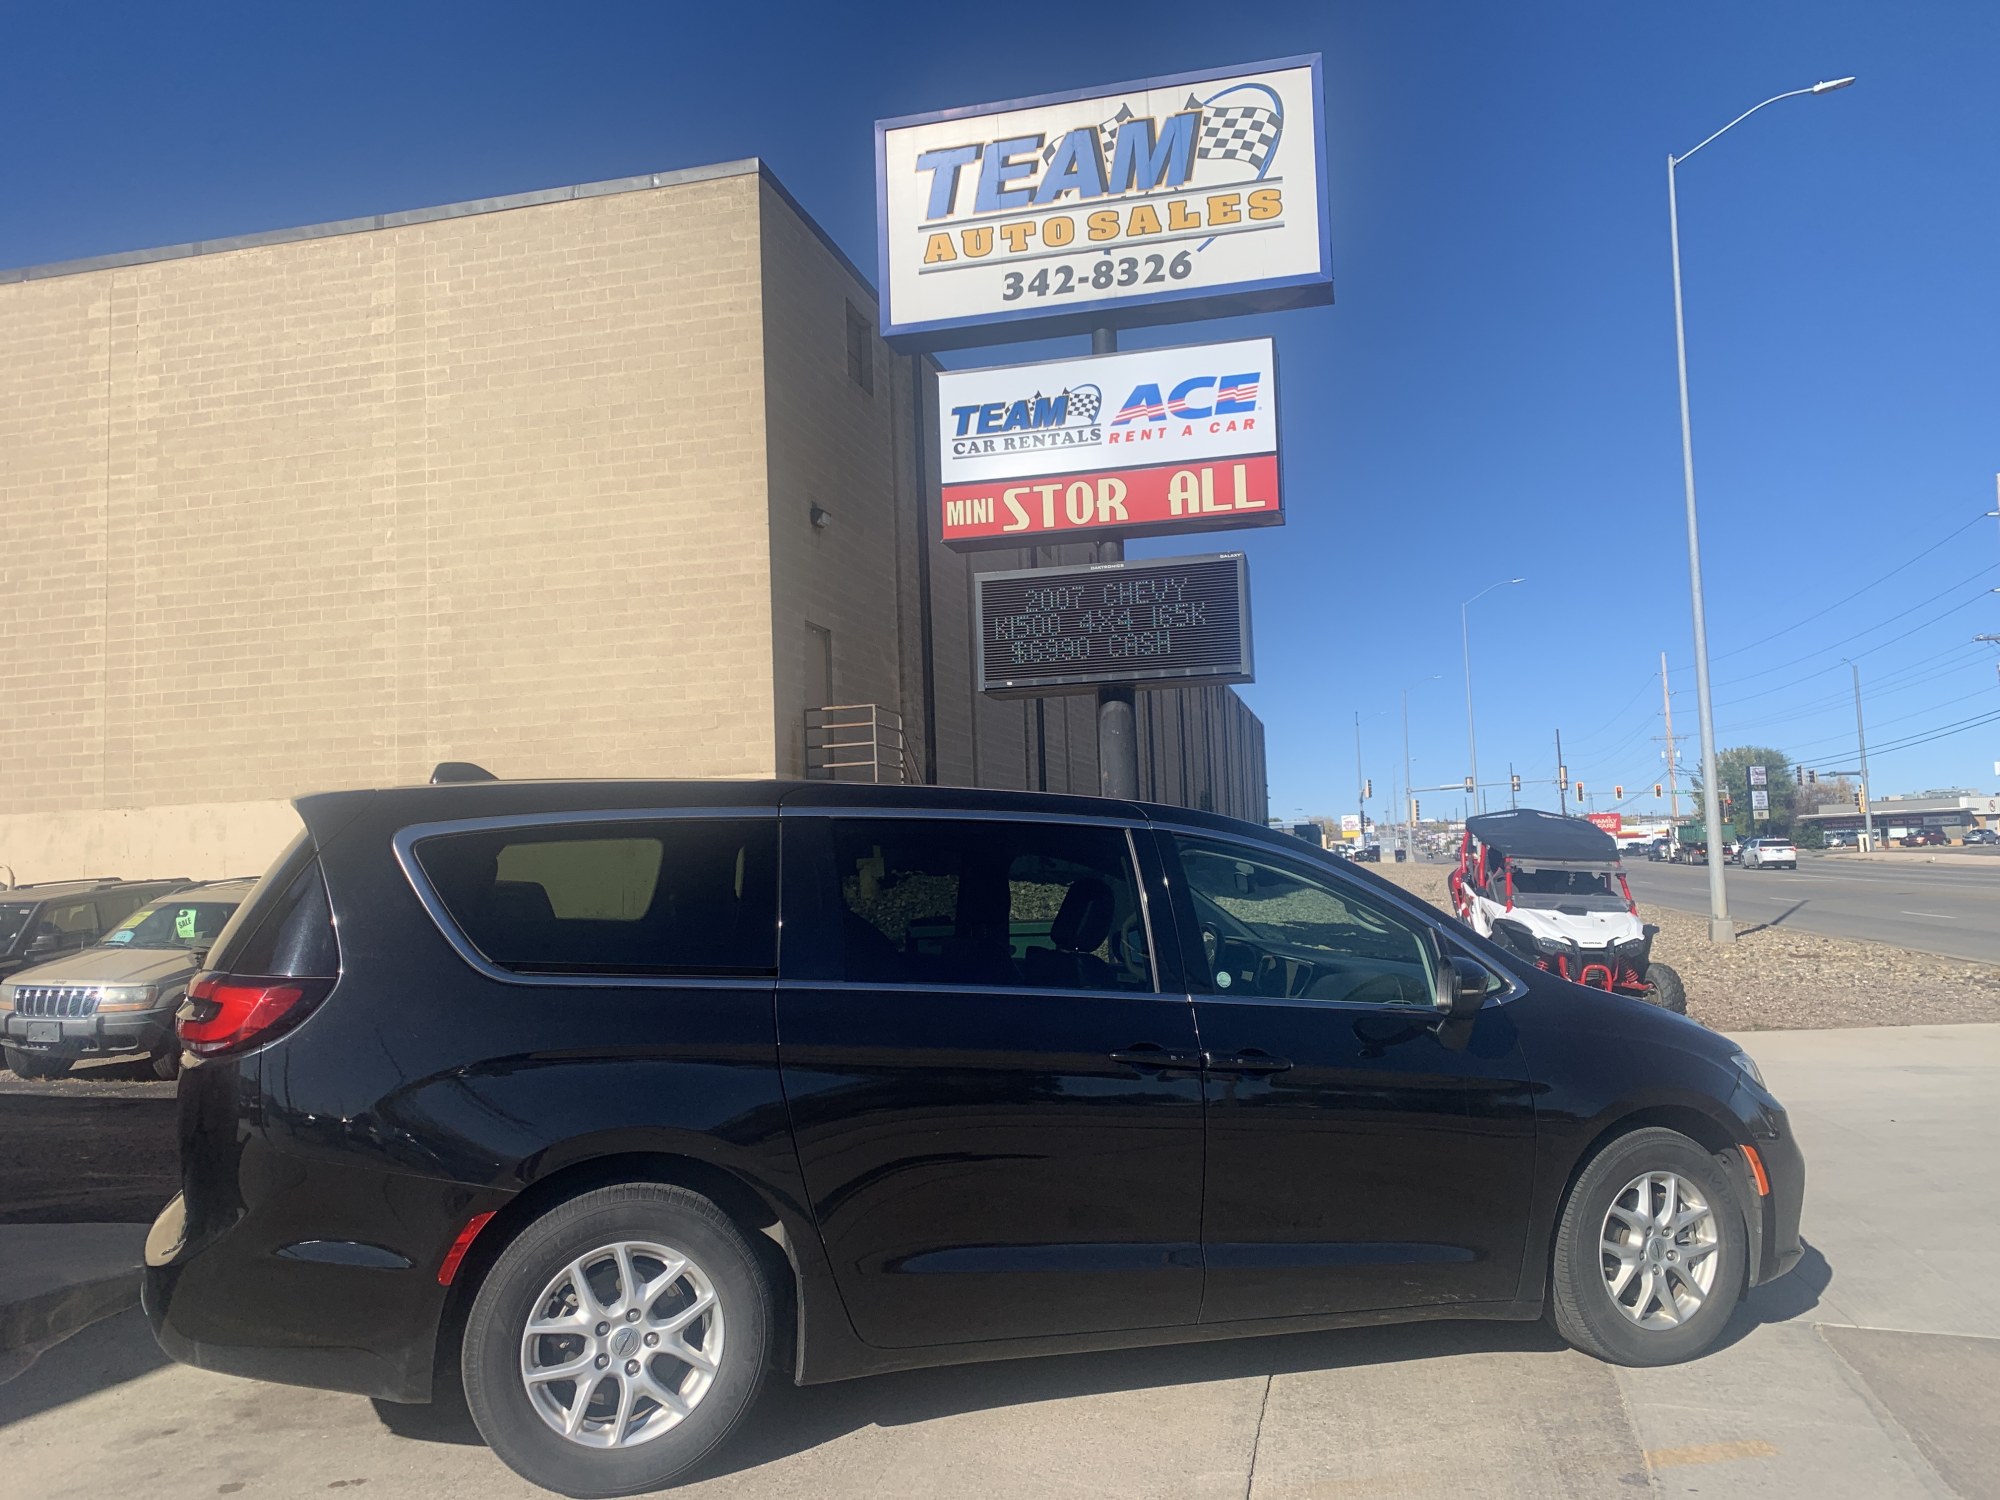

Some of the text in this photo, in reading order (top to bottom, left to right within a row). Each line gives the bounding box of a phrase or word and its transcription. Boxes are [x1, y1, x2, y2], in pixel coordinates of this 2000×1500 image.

[915, 108, 1204, 221] TEAM
[923, 188, 1284, 265] AUTO SALES
[1002, 249, 1193, 301] 342-8326
[951, 395, 1070, 437] TEAM
[1110, 372, 1261, 427] ACE
[953, 427, 1101, 455] CAR RENTALS
[1109, 418, 1256, 445] RENT A CAR
[946, 464, 1266, 532] MINI STOR ALL
[1024, 577, 1188, 613] 2007 CHEVY
[995, 612, 1061, 640] K1500
[1152, 602, 1206, 629] 165K
[1108, 630, 1171, 657] CASH
[178, 917, 192, 929] SALE
